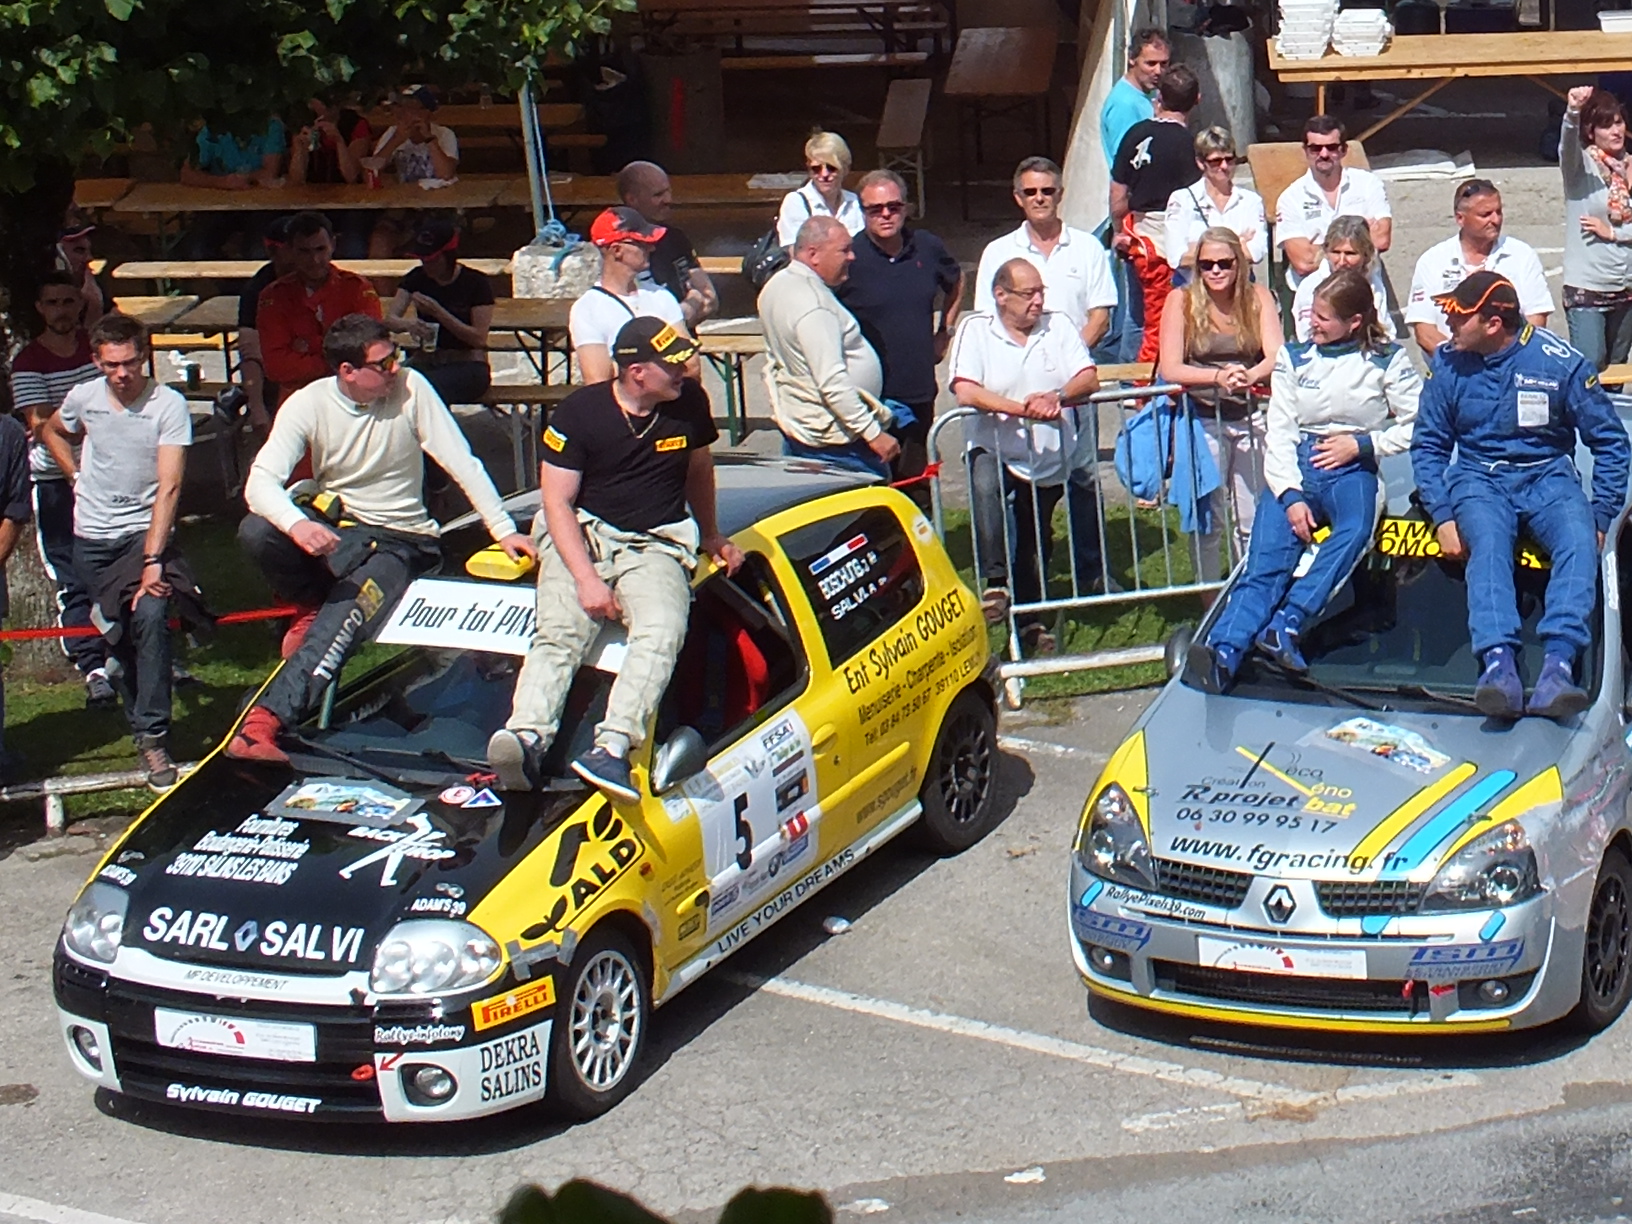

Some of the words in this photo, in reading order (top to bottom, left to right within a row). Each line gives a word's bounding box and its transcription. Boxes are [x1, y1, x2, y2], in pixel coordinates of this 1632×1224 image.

[399, 597, 459, 628] Pour
[459, 599, 503, 633] toi
[843, 660, 871, 695] Ent
[868, 627, 919, 681] Sylvain
[916, 588, 967, 642] GOUGET
[762, 725, 791, 751] FFSA
[733, 791, 753, 870] 5
[1176, 807, 1204, 822] 06
[1208, 809, 1237, 824] 30
[1242, 811, 1270, 827] 99
[1275, 814, 1304, 830] 95
[1310, 818, 1338, 834] 17
[195, 853, 244, 880] SALINS
[232, 856, 264, 882] LES
[252, 858, 299, 886] BAINS
[1170, 834, 1409, 875] www.fgracing.fr
[410, 897, 453, 912] ADAM'S
[450, 901, 467, 915] 39
[717, 922, 751, 955] LIVE
[752, 890, 794, 926] YOUR
[794, 847, 856, 898] DREAMS
[1105, 885, 1207, 920] RallyePixels39.com
[142, 906, 229, 952] SARL
[259, 920, 365, 964] SALVI
[201, 971, 290, 991] DEVELOPPEMENT
[481, 984, 548, 1024] PIRELLI
[479, 1030, 541, 1074] DEKRA
[166, 1083, 240, 1105] Sylvain
[241, 1091, 322, 1115] GOUGET
[480, 1060, 542, 1103] SALINS
